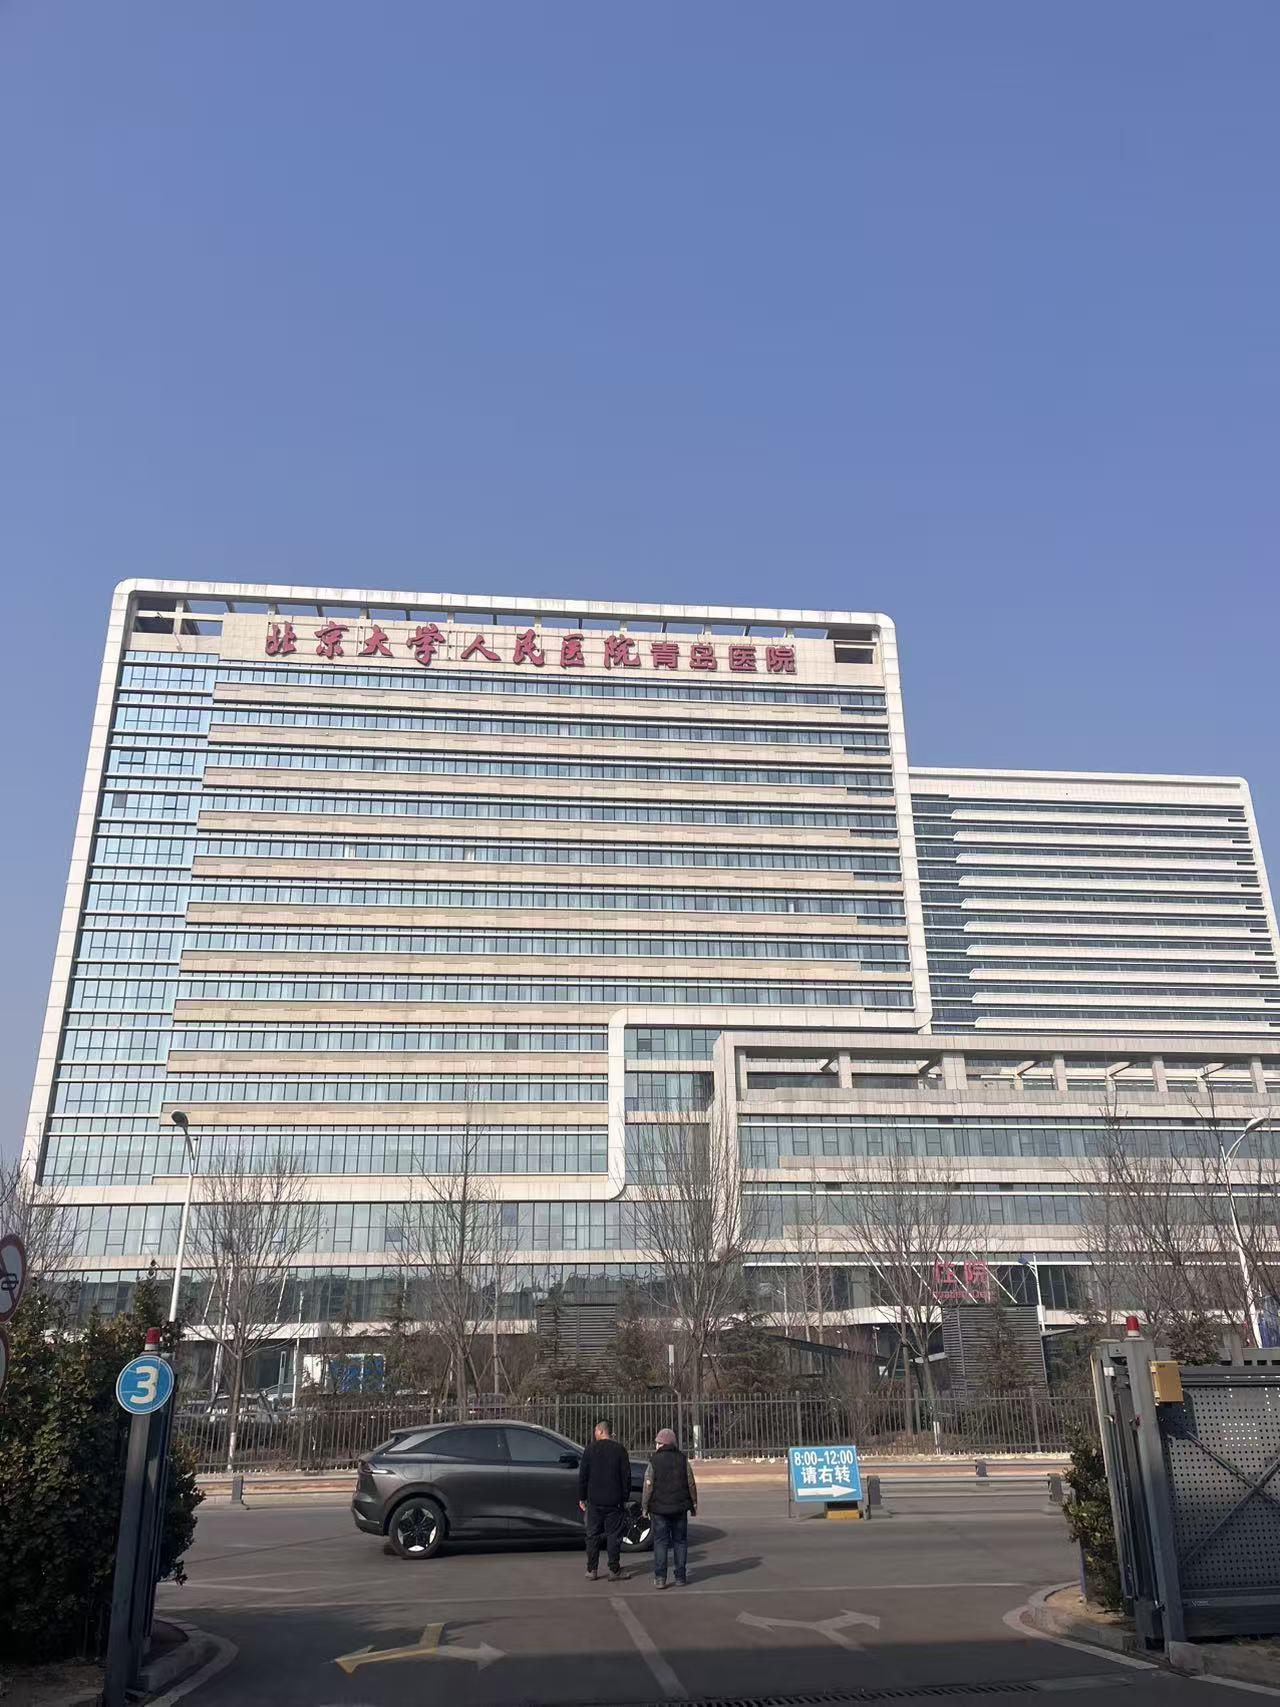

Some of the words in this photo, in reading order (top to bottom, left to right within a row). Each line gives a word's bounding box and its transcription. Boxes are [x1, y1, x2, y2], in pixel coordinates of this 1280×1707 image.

[130, 1365, 158, 1404] 3
[794, 1450, 854, 1466] 8:00-12:00
[801, 1465, 851, 1484] 请右转
